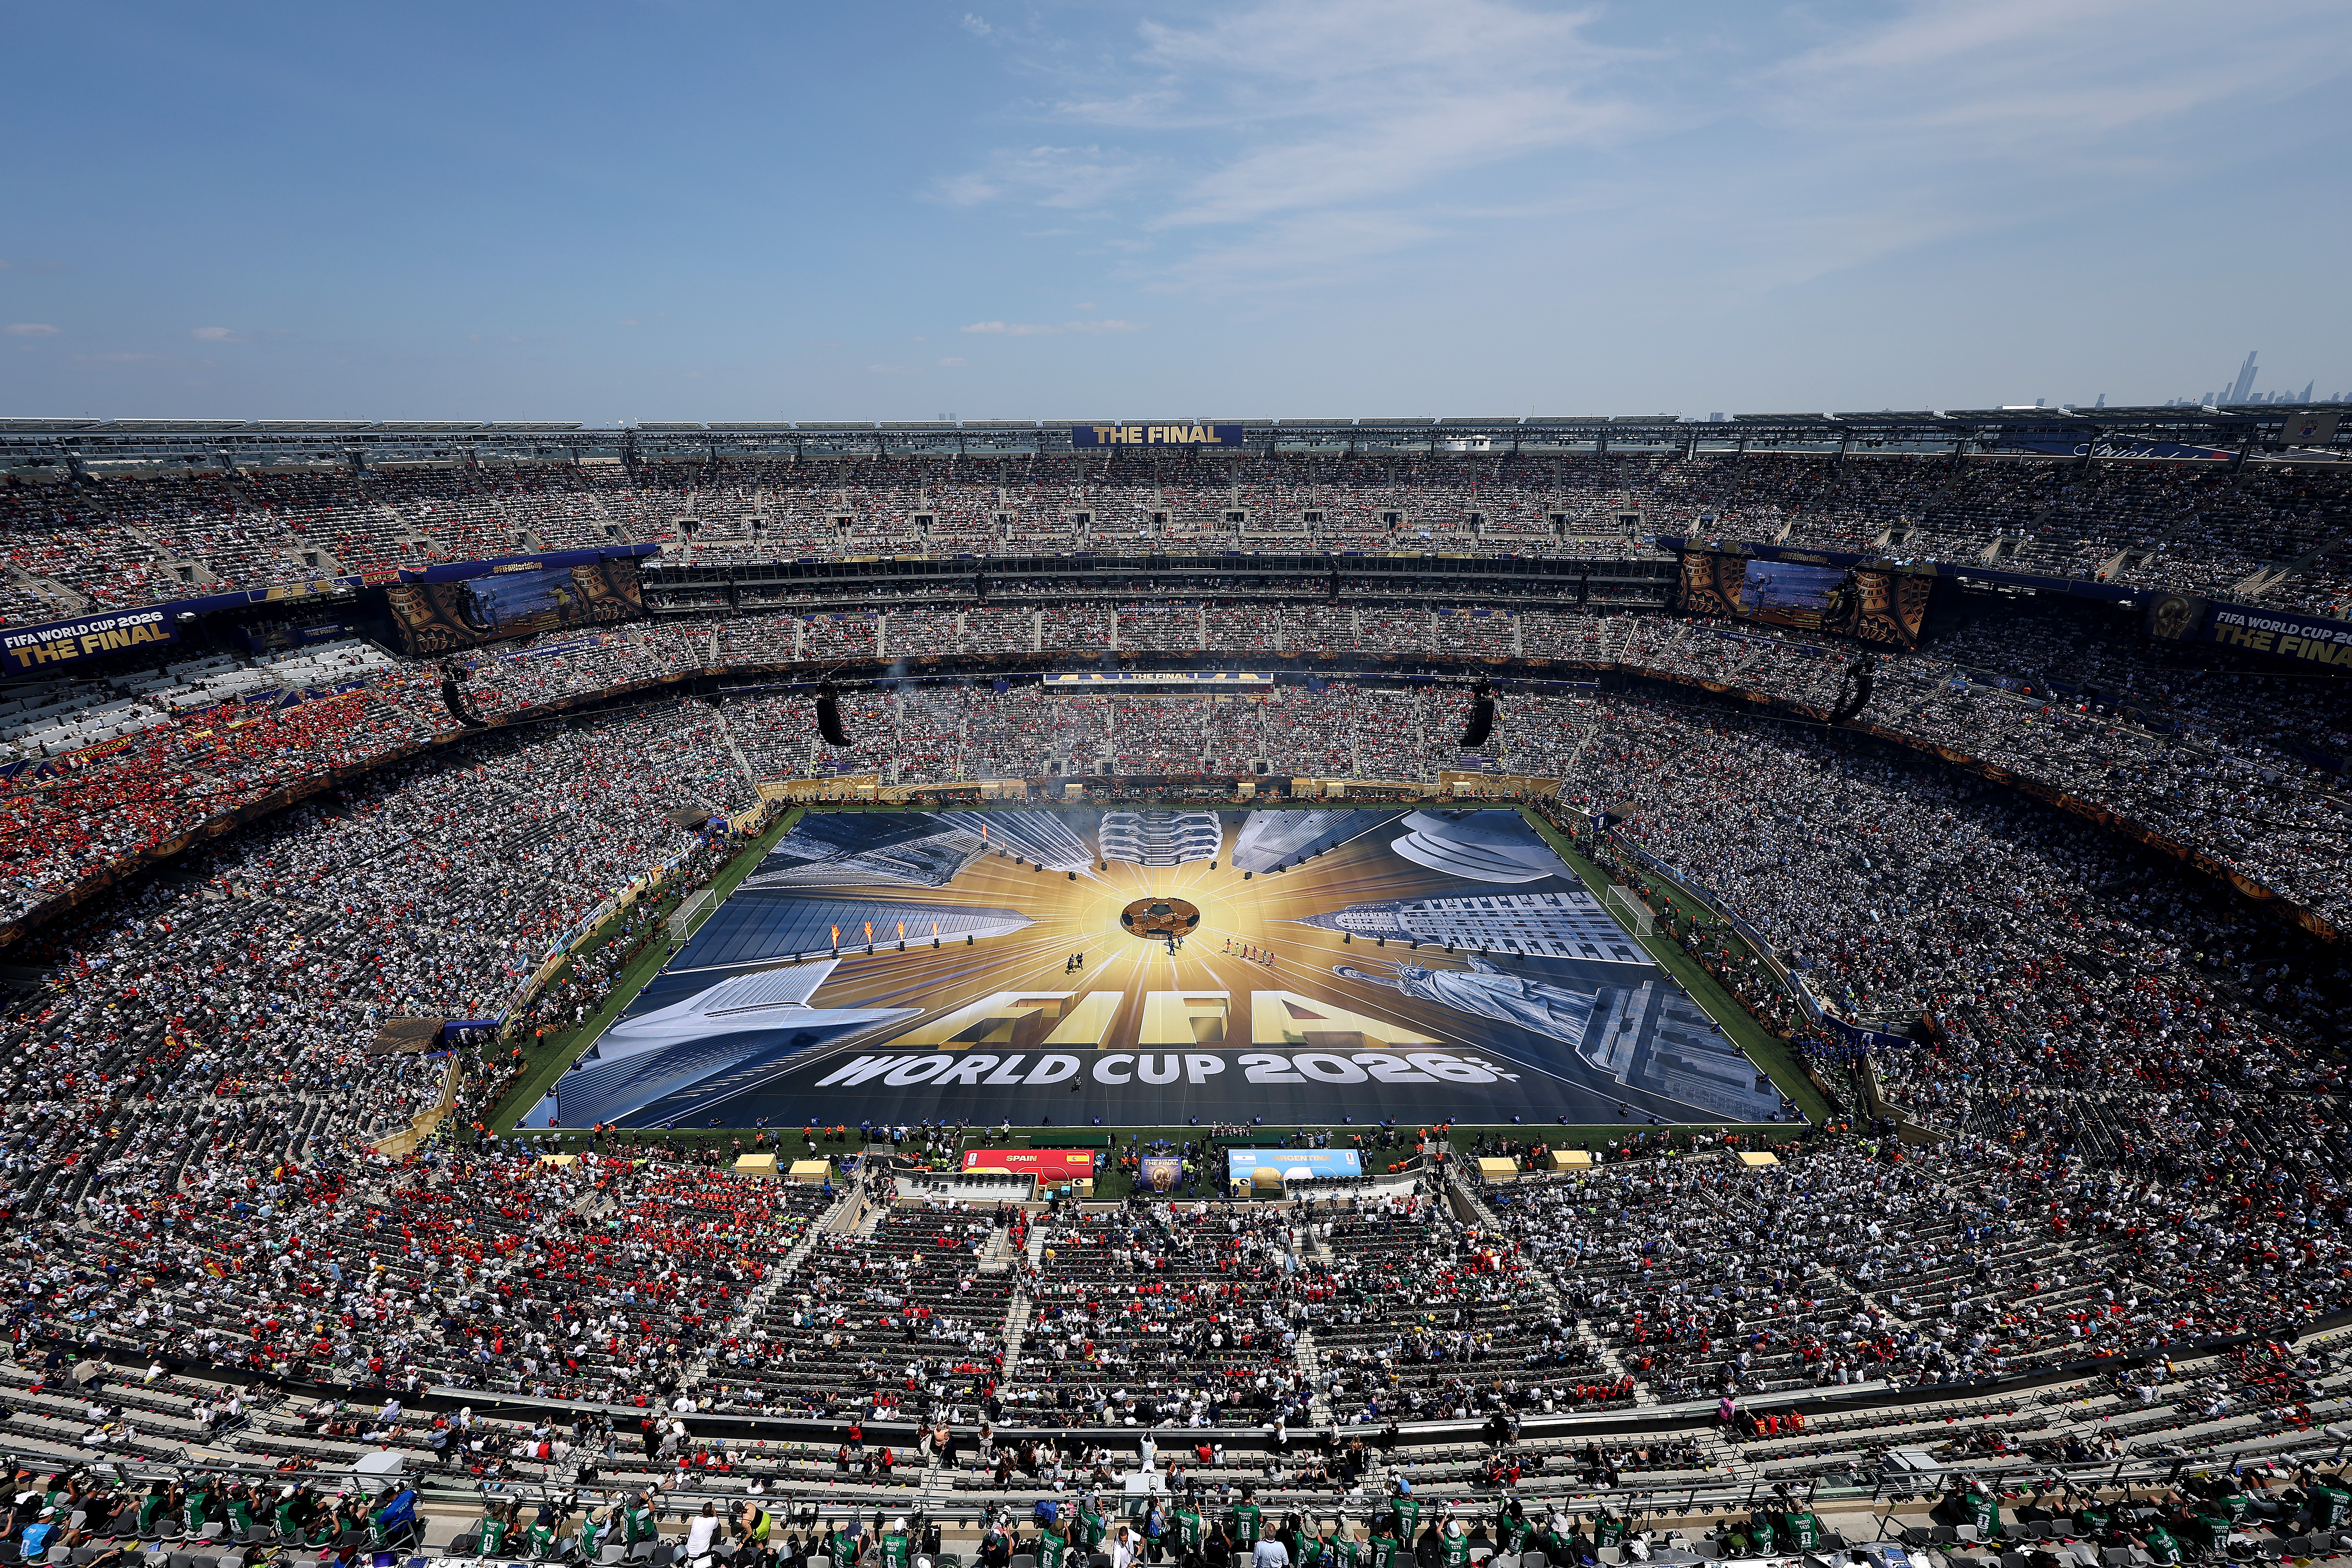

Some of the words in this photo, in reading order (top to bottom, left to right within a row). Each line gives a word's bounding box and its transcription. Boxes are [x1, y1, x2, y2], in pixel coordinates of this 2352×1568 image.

[1093, 427, 1142, 443] THE
[1148, 426, 1221, 443] FINAL
[493, 561, 542, 573] #FIFAWorldCup
[1779, 552, 1828, 564] #FIFAWorldCup
[4, 634, 38, 648] FIFA
[36, 625, 88, 642] WORLD
[90, 619, 116, 632] CUP
[118, 612, 163, 627] 2026
[2214, 623, 2276, 651] THE
[2217, 612, 2245, 625] FIFA
[2249, 617, 2299, 634] WORLD
[2301, 627, 2332, 640] CUP
[9, 639, 79, 666] THE
[81, 623, 170, 654] FINAL
[881, 990, 1451, 1049] FIFA
[815, 1053, 1080, 1087] WORLD
[1092, 1053, 1226, 1085] CUP
[1243, 1053, 1511, 1083] 2026
[1044, 1537, 1057, 1547] PHOTO
